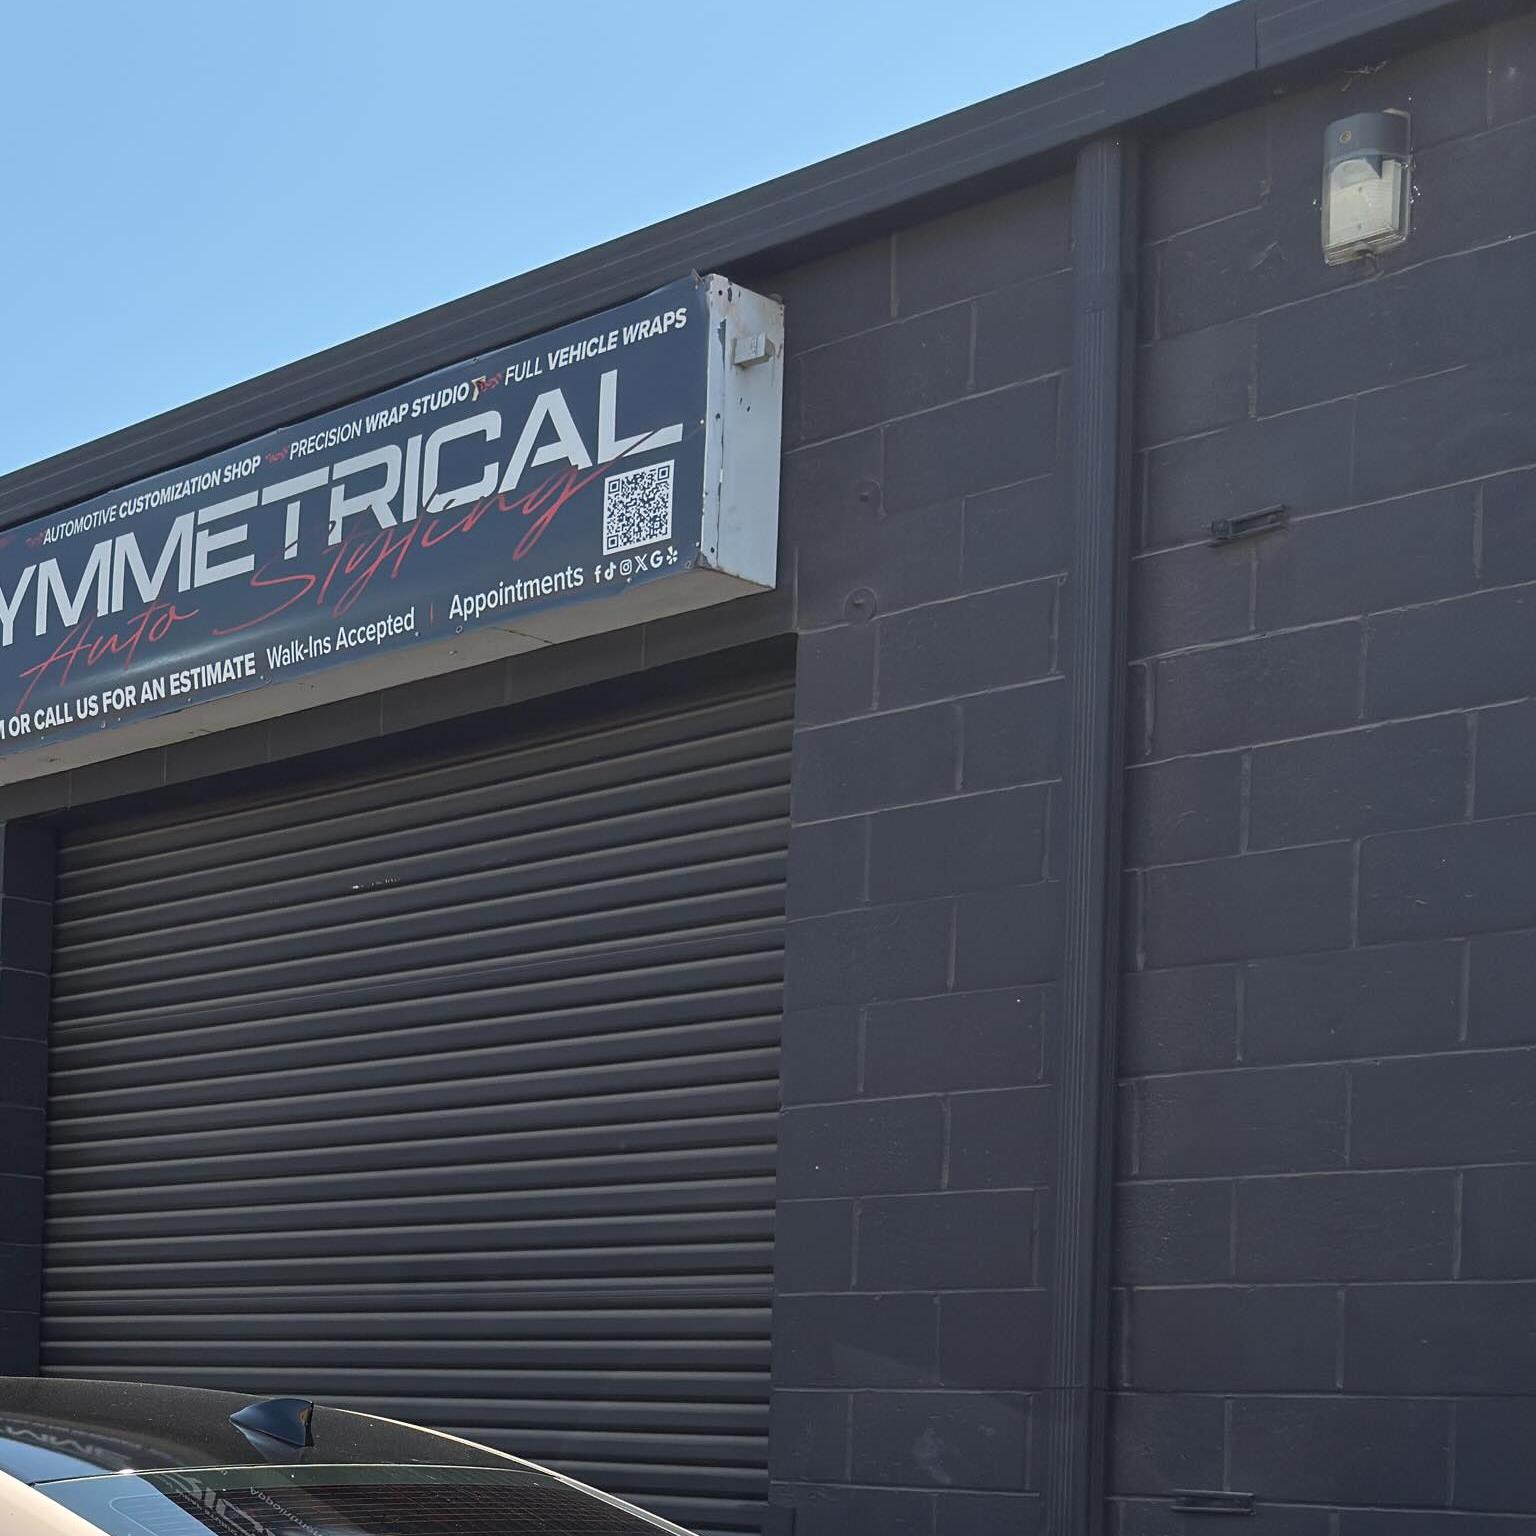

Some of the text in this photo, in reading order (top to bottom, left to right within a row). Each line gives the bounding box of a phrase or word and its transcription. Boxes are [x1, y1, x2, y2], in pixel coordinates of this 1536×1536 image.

[504, 356, 543, 386] FULL
[547, 330, 619, 371] VEHICLE
[622, 307, 688, 345] WRAPS
[289, 419, 363, 460] PRECISION
[365, 403, 409, 434] WRAP
[410, 382, 470, 417] STUDIO
[43, 505, 117, 545] AUTOMOTIVE
[118, 469, 222, 518] CUSTOMIZATION
[223, 454, 261, 484] SHOP
[448, 566, 584, 621] Appointments
[14, 598, 199, 713] Auto
[266, 607, 415, 670] Walk-Ins Accepted
[8, 714, 31, 737] OR
[33, 704, 73, 729] CALL
[76, 695, 99, 720] US
[102, 685, 137, 714] FOR
[140, 677, 166, 704] AN
[170, 652, 256, 696] ESTIMATE
